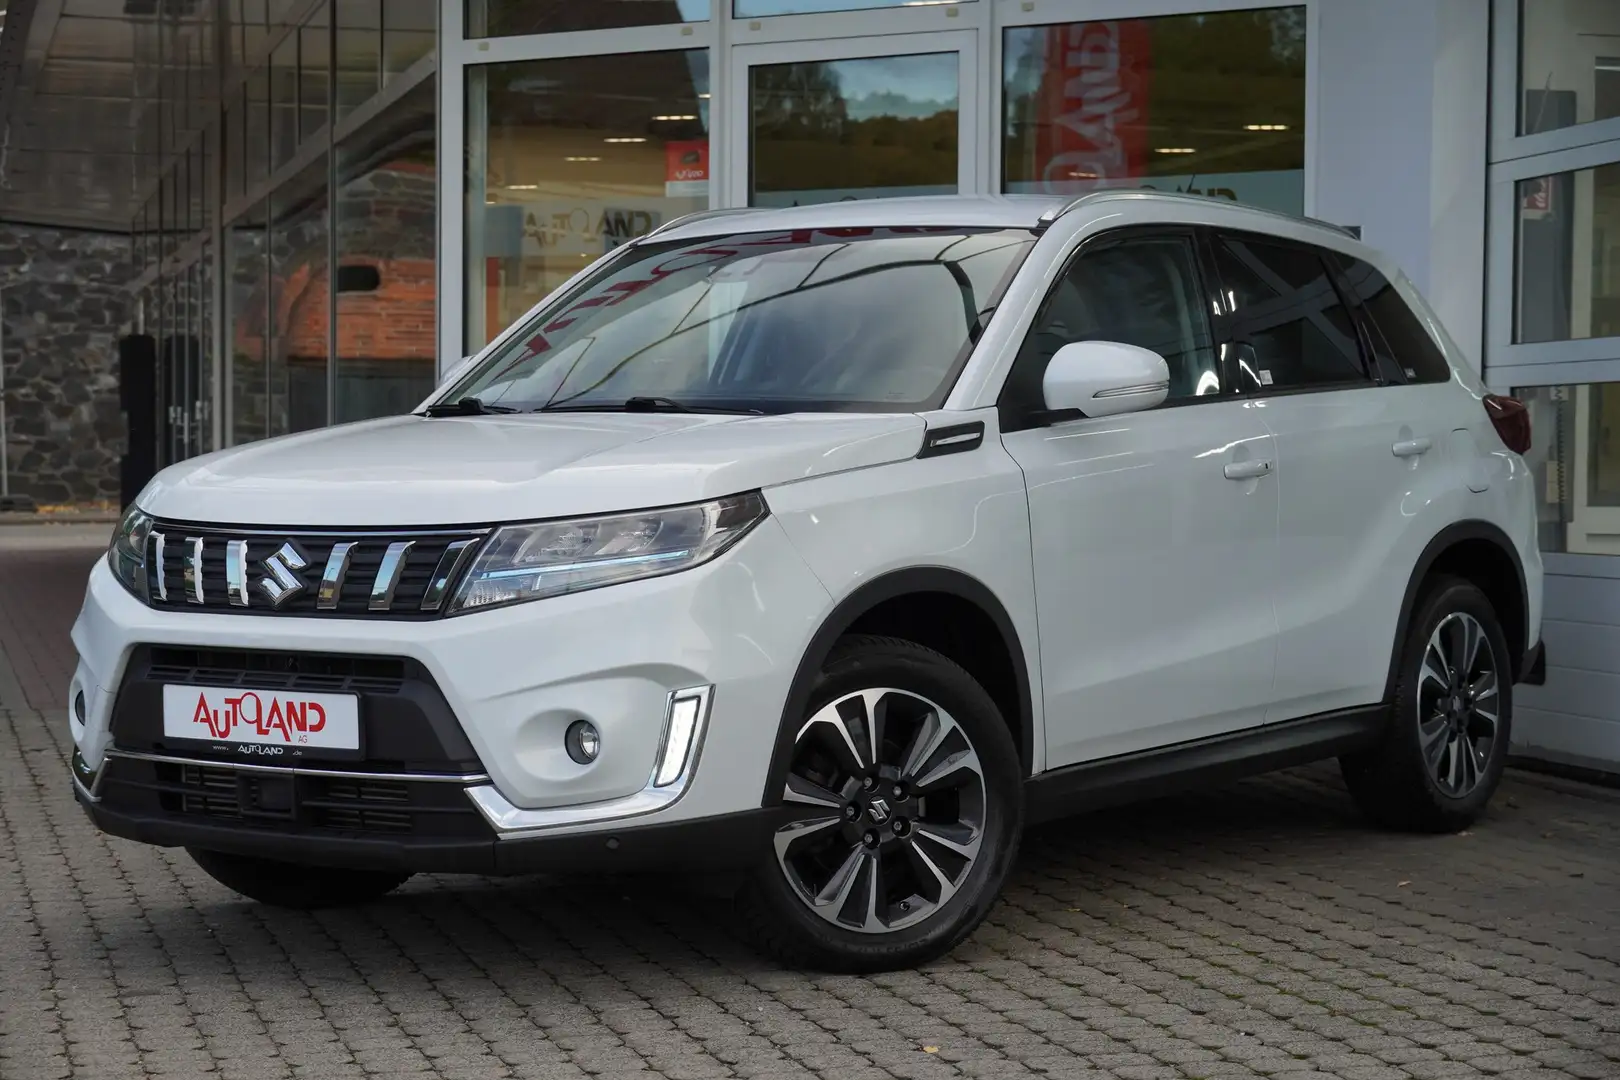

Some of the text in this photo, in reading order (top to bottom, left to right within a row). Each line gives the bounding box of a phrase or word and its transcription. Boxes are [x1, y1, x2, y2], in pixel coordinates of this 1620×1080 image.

[193, 692, 326, 742] AUTOLAND
[298, 735, 308, 744] AG
[237, 744, 284, 756] AUTOLAND
